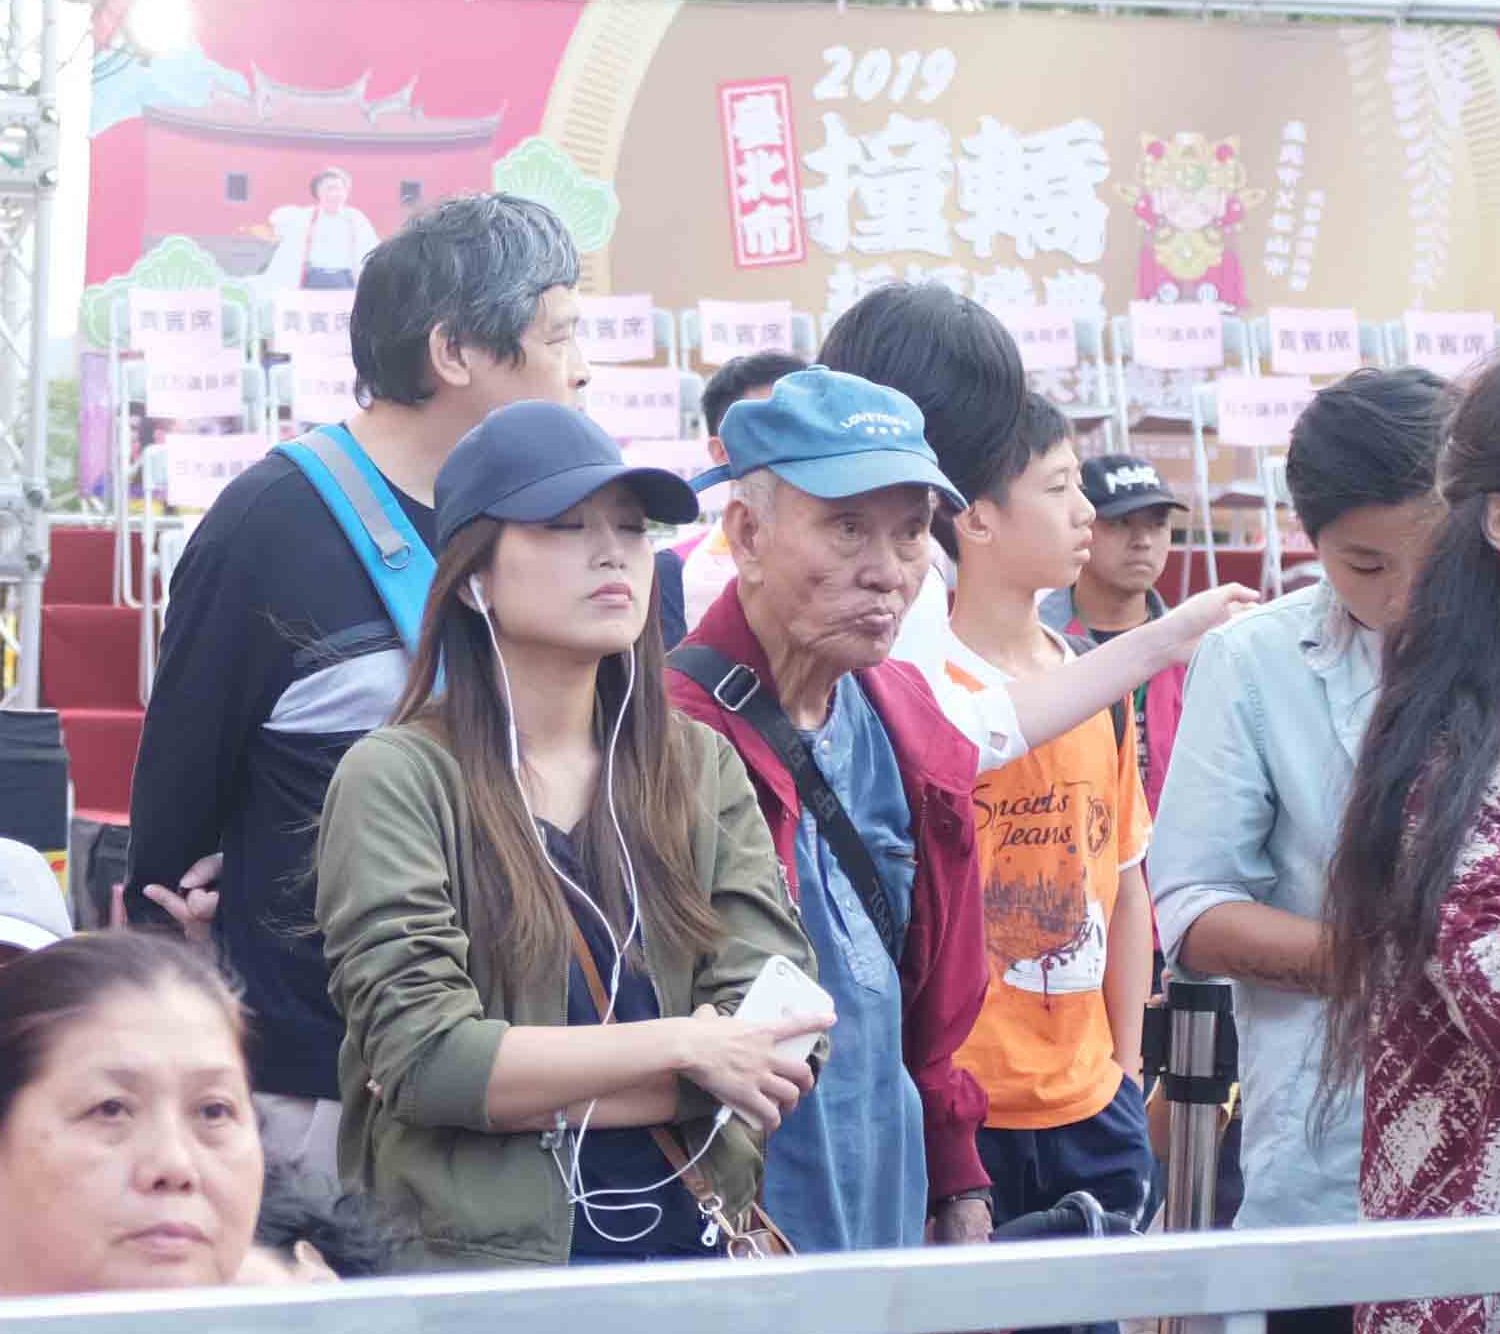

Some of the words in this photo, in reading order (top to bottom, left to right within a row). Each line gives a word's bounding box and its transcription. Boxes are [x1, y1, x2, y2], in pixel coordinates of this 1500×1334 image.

[813, 45, 957, 103] 2019
[732, 93, 793, 255] 臺北市
[801, 111, 1111, 264] 撞轎
[994, 821, 1073, 853] Jeans
